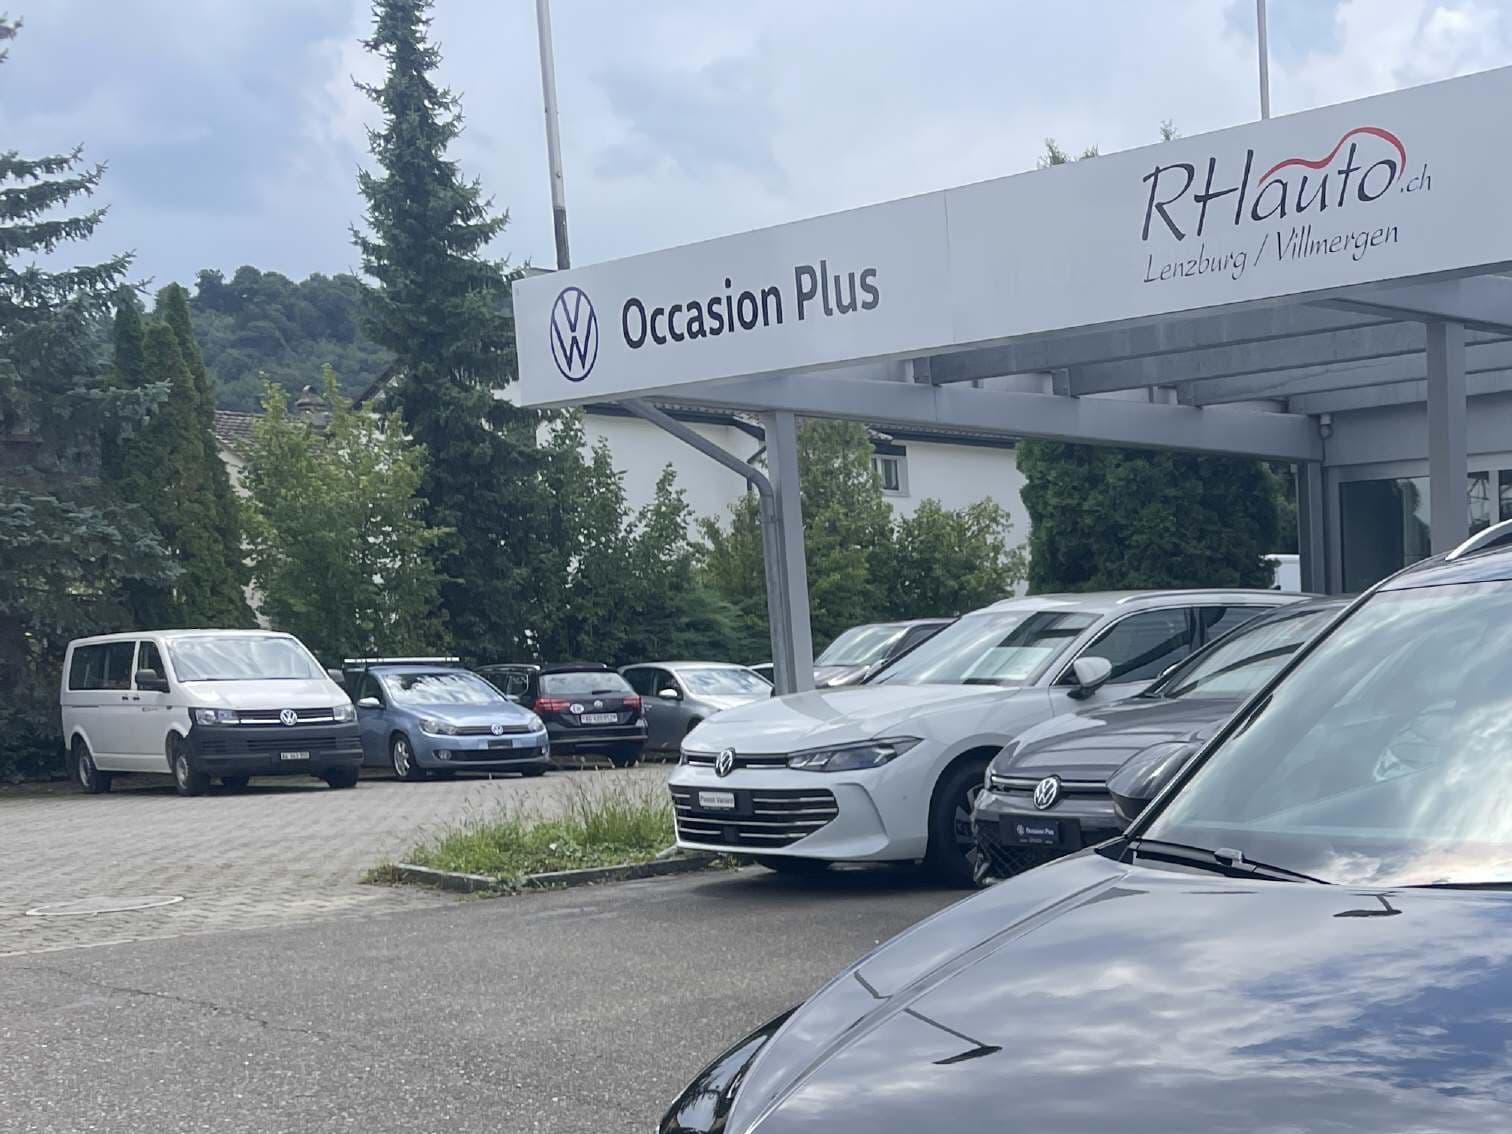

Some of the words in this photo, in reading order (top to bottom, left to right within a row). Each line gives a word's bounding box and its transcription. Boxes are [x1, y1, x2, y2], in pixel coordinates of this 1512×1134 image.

[1143, 243, 1248, 283] Lenzburg
[1277, 223, 1399, 261] Villmergen
[622, 277, 783, 349] Occasion
[794, 260, 880, 322] Plus
